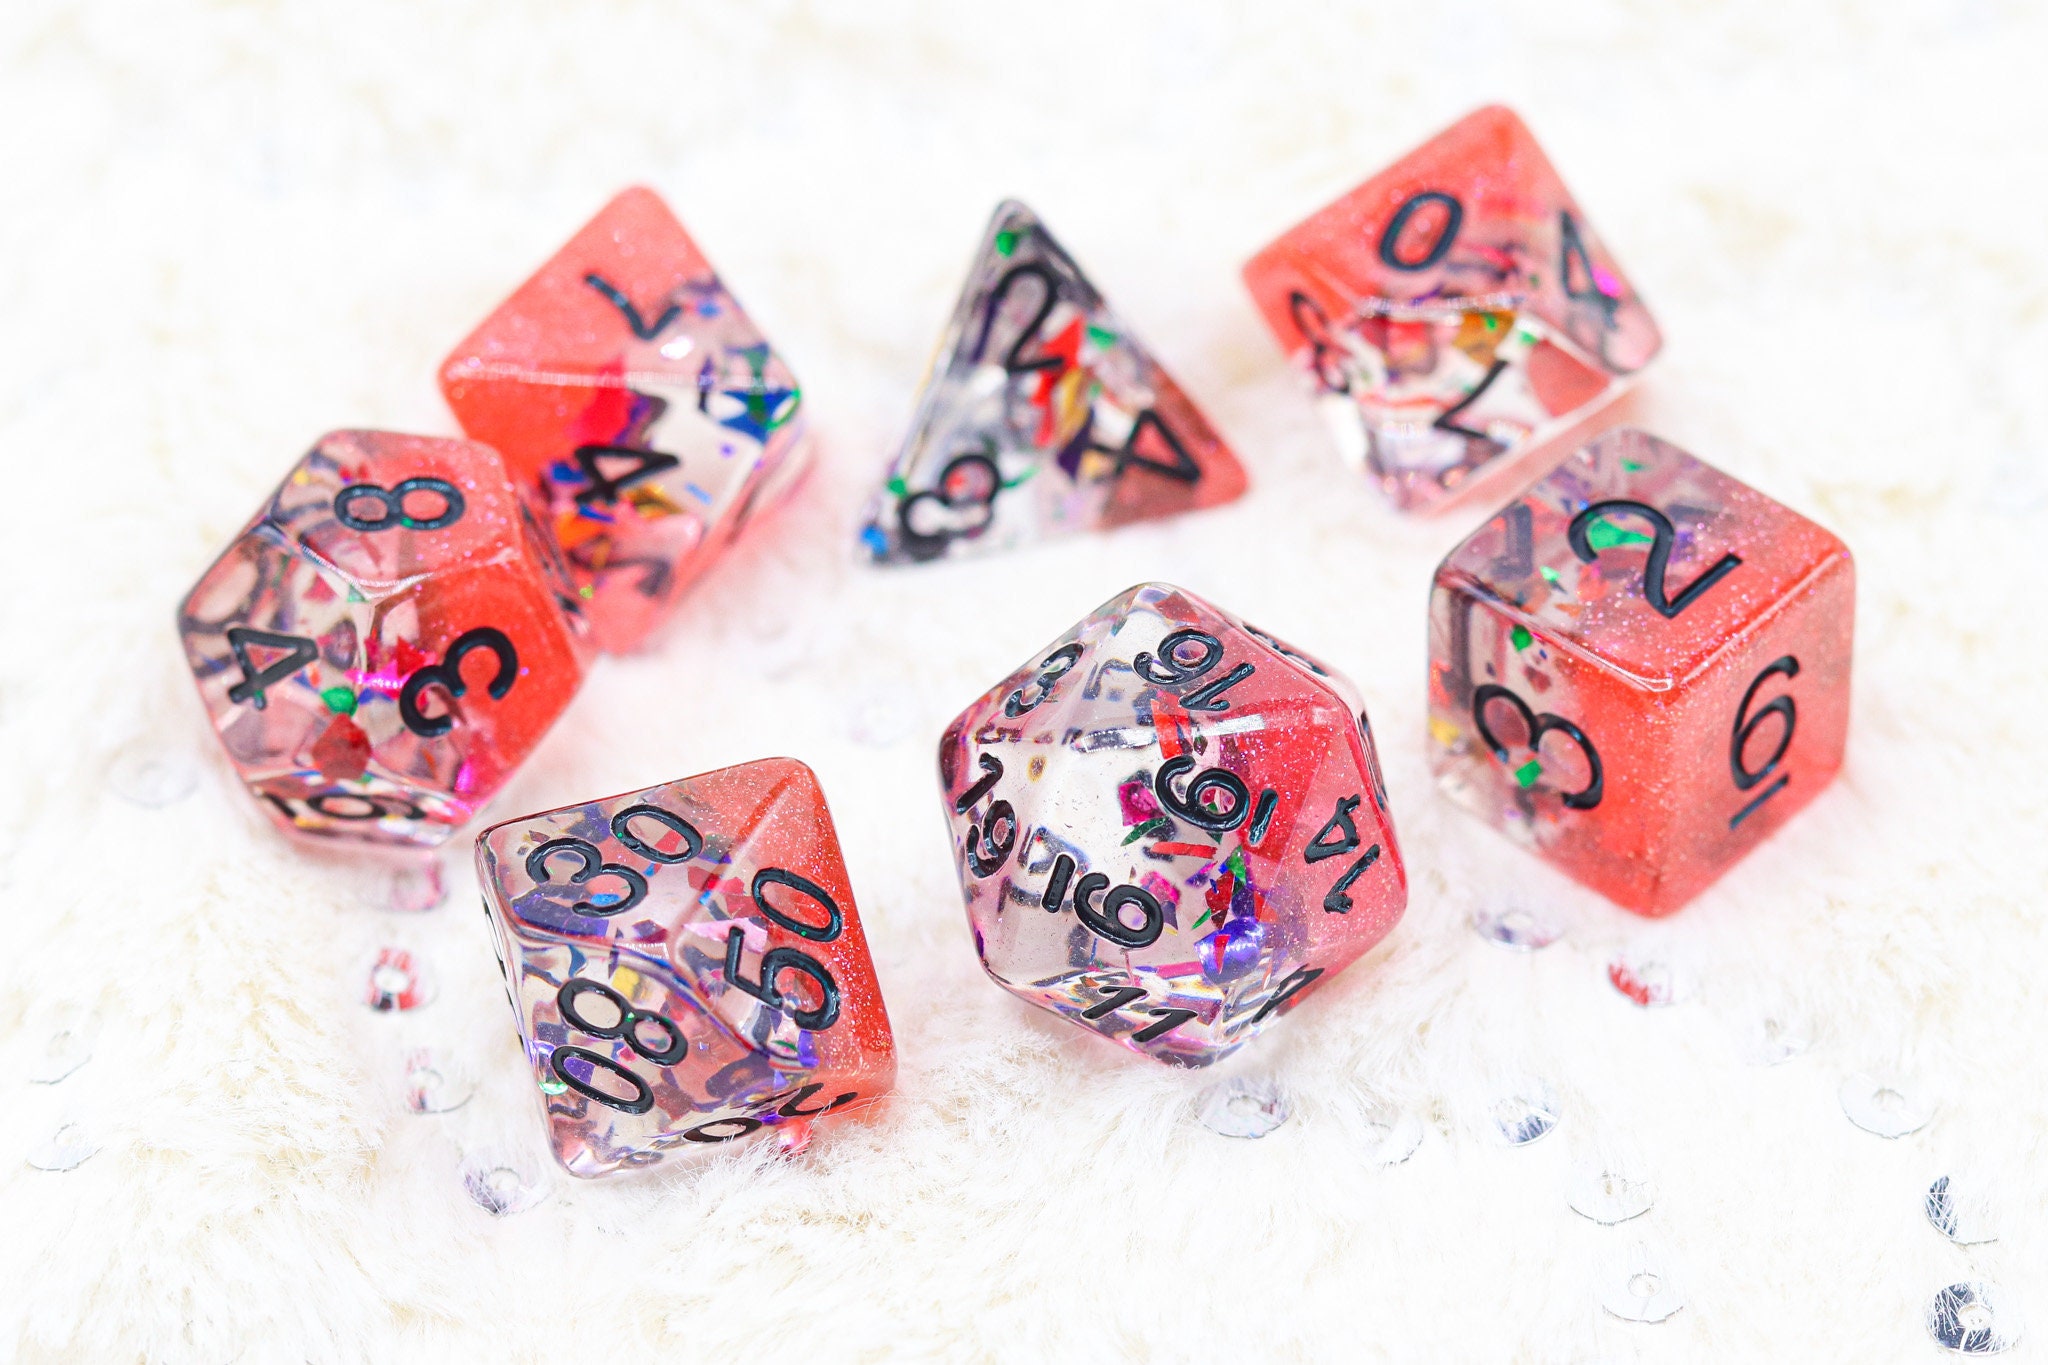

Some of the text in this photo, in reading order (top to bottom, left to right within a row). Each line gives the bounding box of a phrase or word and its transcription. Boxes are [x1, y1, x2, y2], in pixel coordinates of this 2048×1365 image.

[1378, 191, 1463, 272] 0
[990, 262, 1064, 371] 2
[574, 444, 680, 507] 4
[1090, 409, 1201, 483] 4
[334, 477, 466, 532] 8
[1567, 500, 1743, 618] 2
[227, 627, 319, 710] 4
[400, 627, 518, 738] 3
[1004, 641, 1084, 720] 3
[1133, 627, 1256, 711] 16
[1473, 684, 1603, 810] 3
[1730, 654, 1801, 830] 6
[526, 804, 704, 918] 30
[956, 752, 1017, 880] 19
[1304, 794, 1381, 915] 14
[723, 866, 842, 1032] 50
[551, 977, 688, 1115] 80
[1080, 985, 1200, 1043] 11
